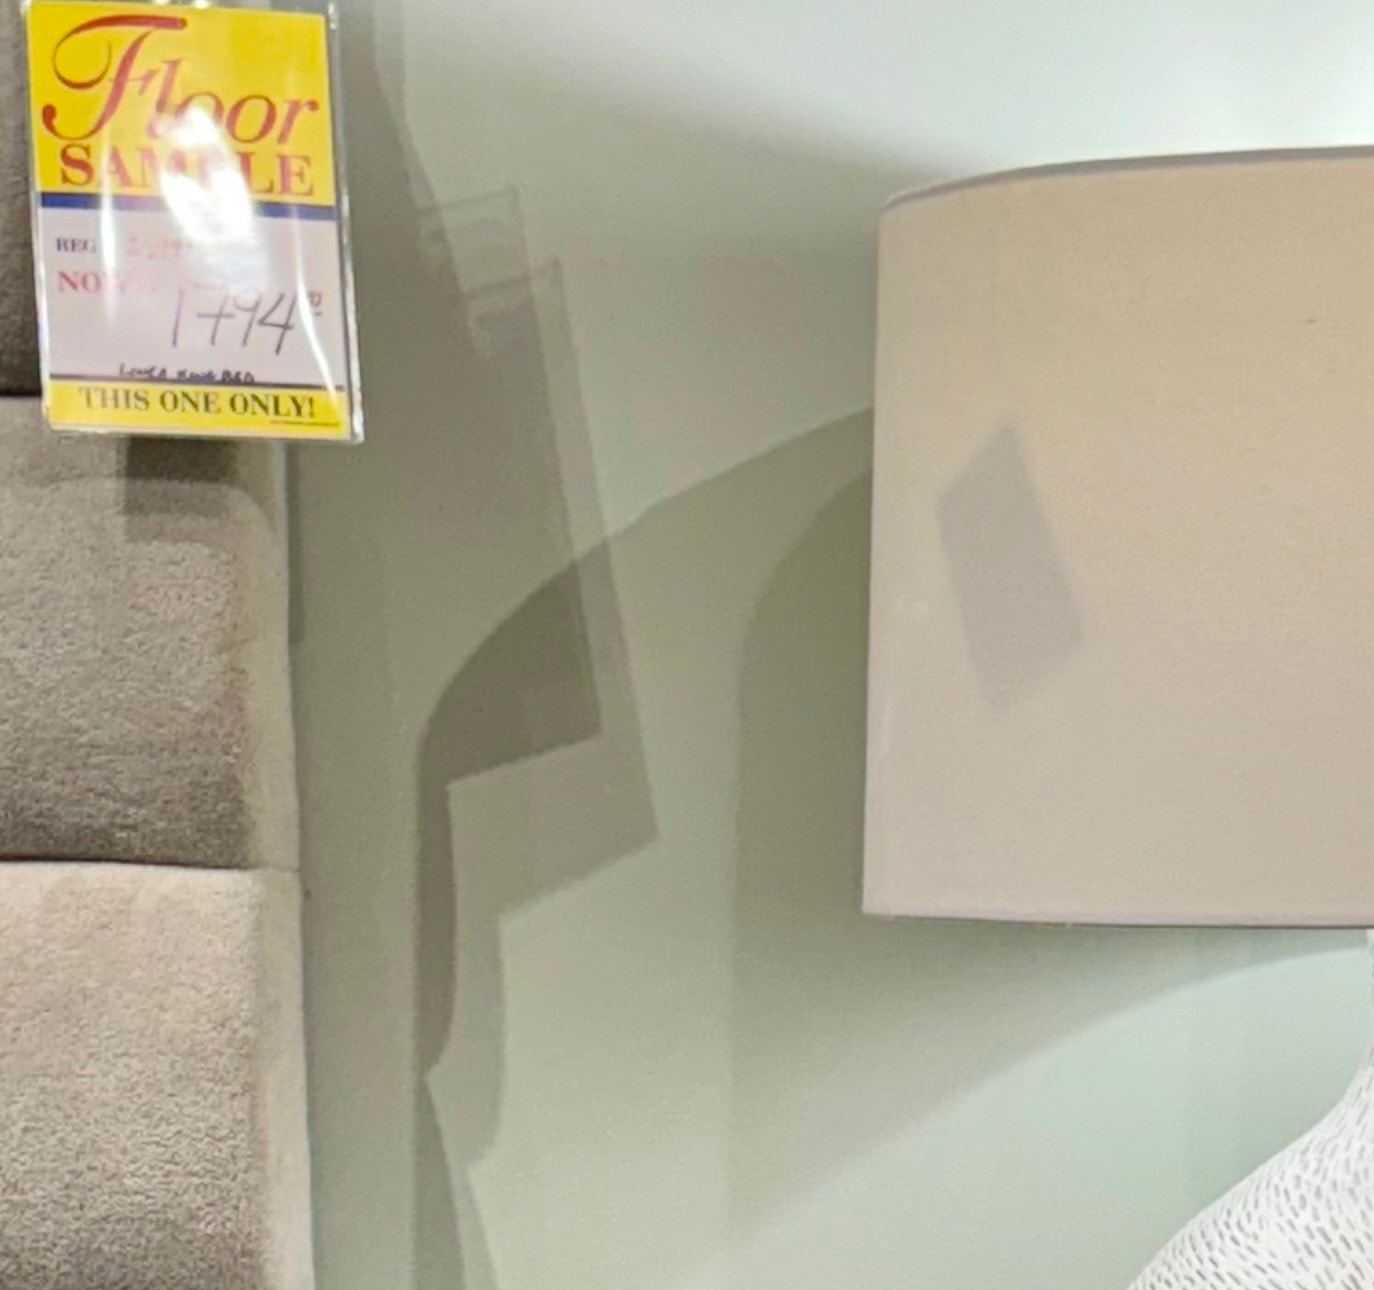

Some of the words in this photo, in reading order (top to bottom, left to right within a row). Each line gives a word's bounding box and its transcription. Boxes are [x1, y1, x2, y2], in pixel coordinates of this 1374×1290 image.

[42, 14, 320, 146] Floor
[79, 386, 150, 412] THIS
[160, 390, 222, 416] ONE
[229, 393, 316, 419] ONLY!
